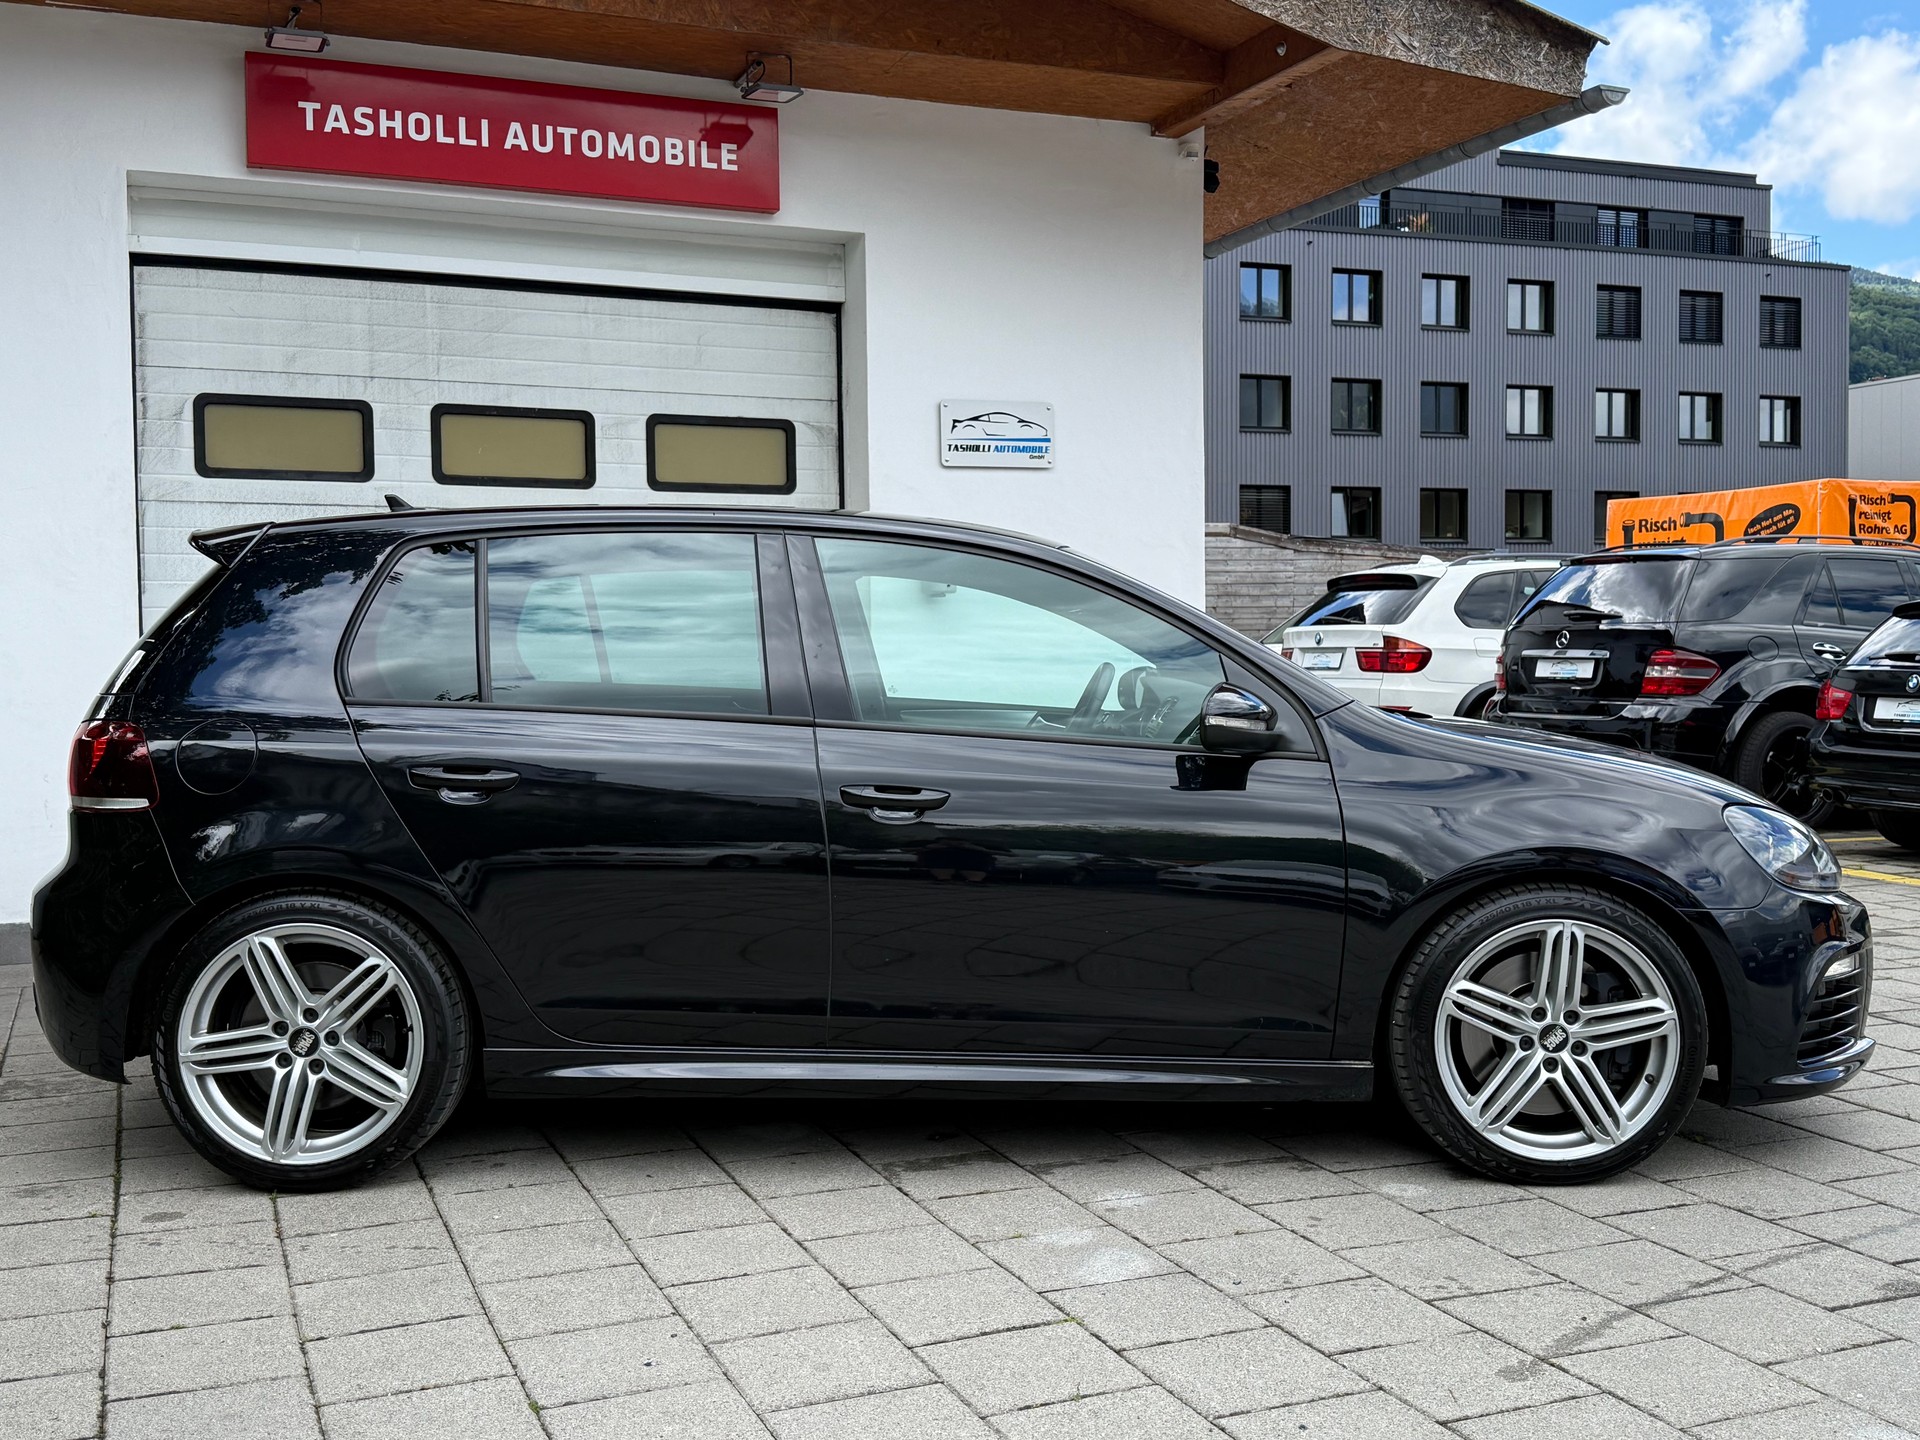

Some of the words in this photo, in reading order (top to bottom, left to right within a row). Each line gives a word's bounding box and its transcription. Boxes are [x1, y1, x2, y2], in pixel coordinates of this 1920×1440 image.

[299, 101, 489, 148] TASHOLLI
[503, 121, 738, 171] AUTOMOBILE
[946, 444, 992, 453] TASHOLLI
[992, 444, 1051, 454] AUTOMOBILE
[1858, 494, 1887, 506] Risch
[1858, 509, 1892, 524] reinigt
[1638, 516, 1677, 533] Risch
[1858, 523, 1891, 535] Rohre
[1893, 524, 1908, 535] AG
[1543, 1027, 1567, 1052] SPACE
